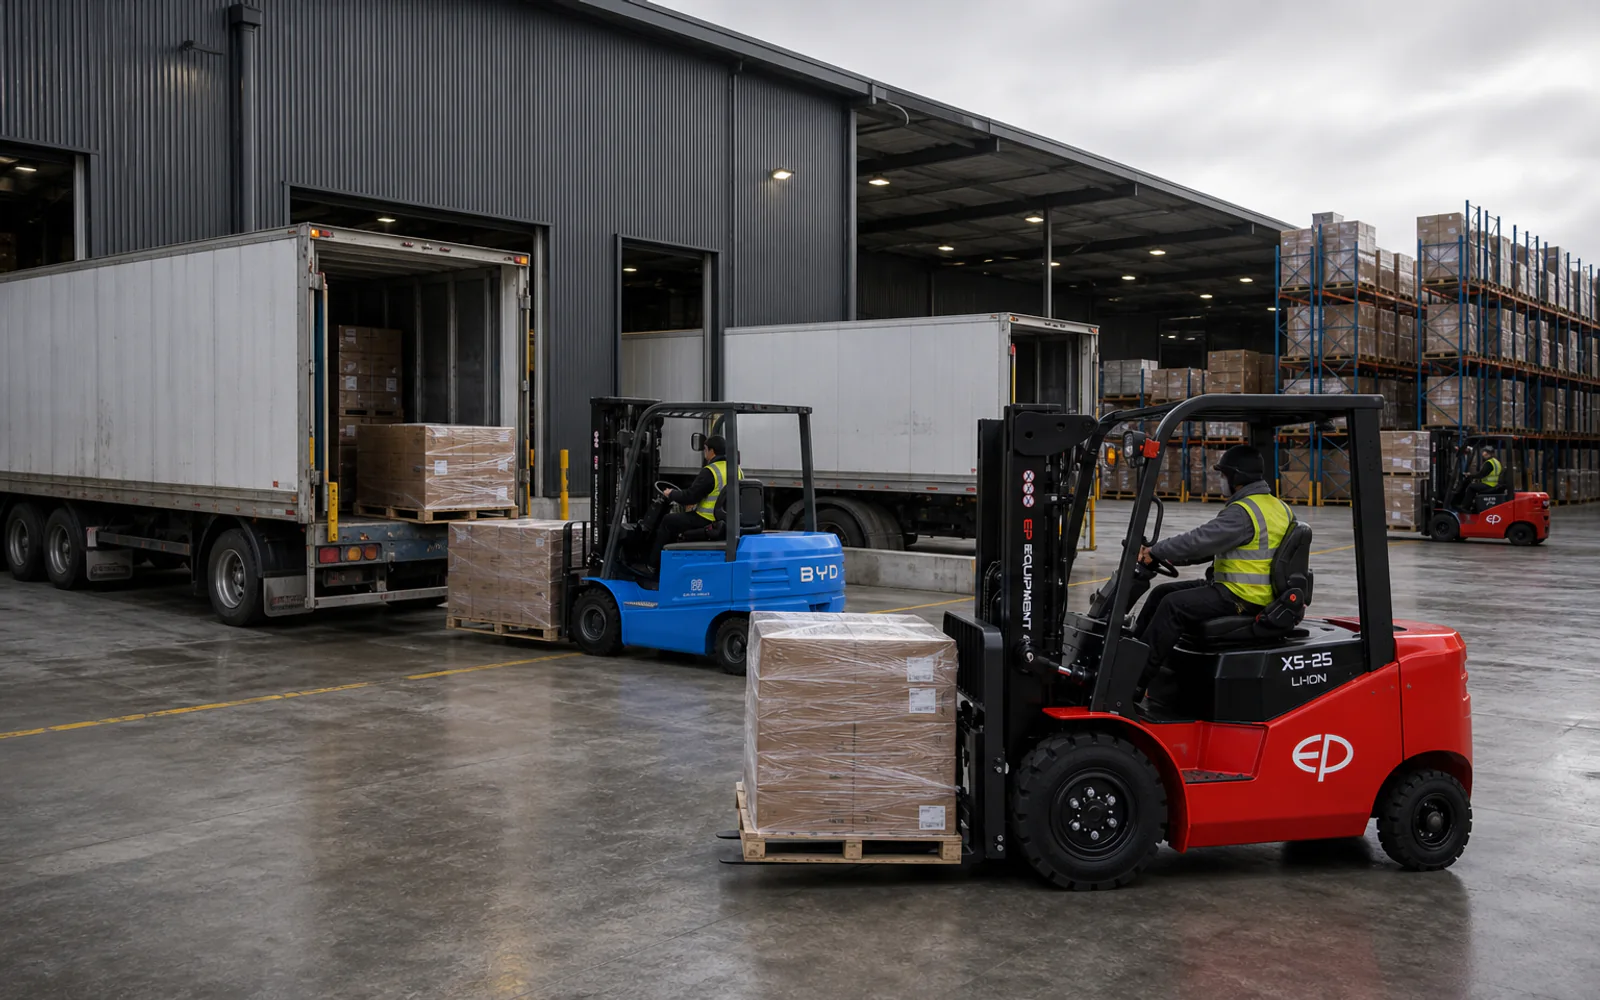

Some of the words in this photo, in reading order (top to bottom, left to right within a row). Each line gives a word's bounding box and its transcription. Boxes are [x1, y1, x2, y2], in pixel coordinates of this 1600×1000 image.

[1023, 518, 1033, 540] EP
[800, 564, 838, 582] BYD
[1291, 673, 1327, 687] LI-ION
